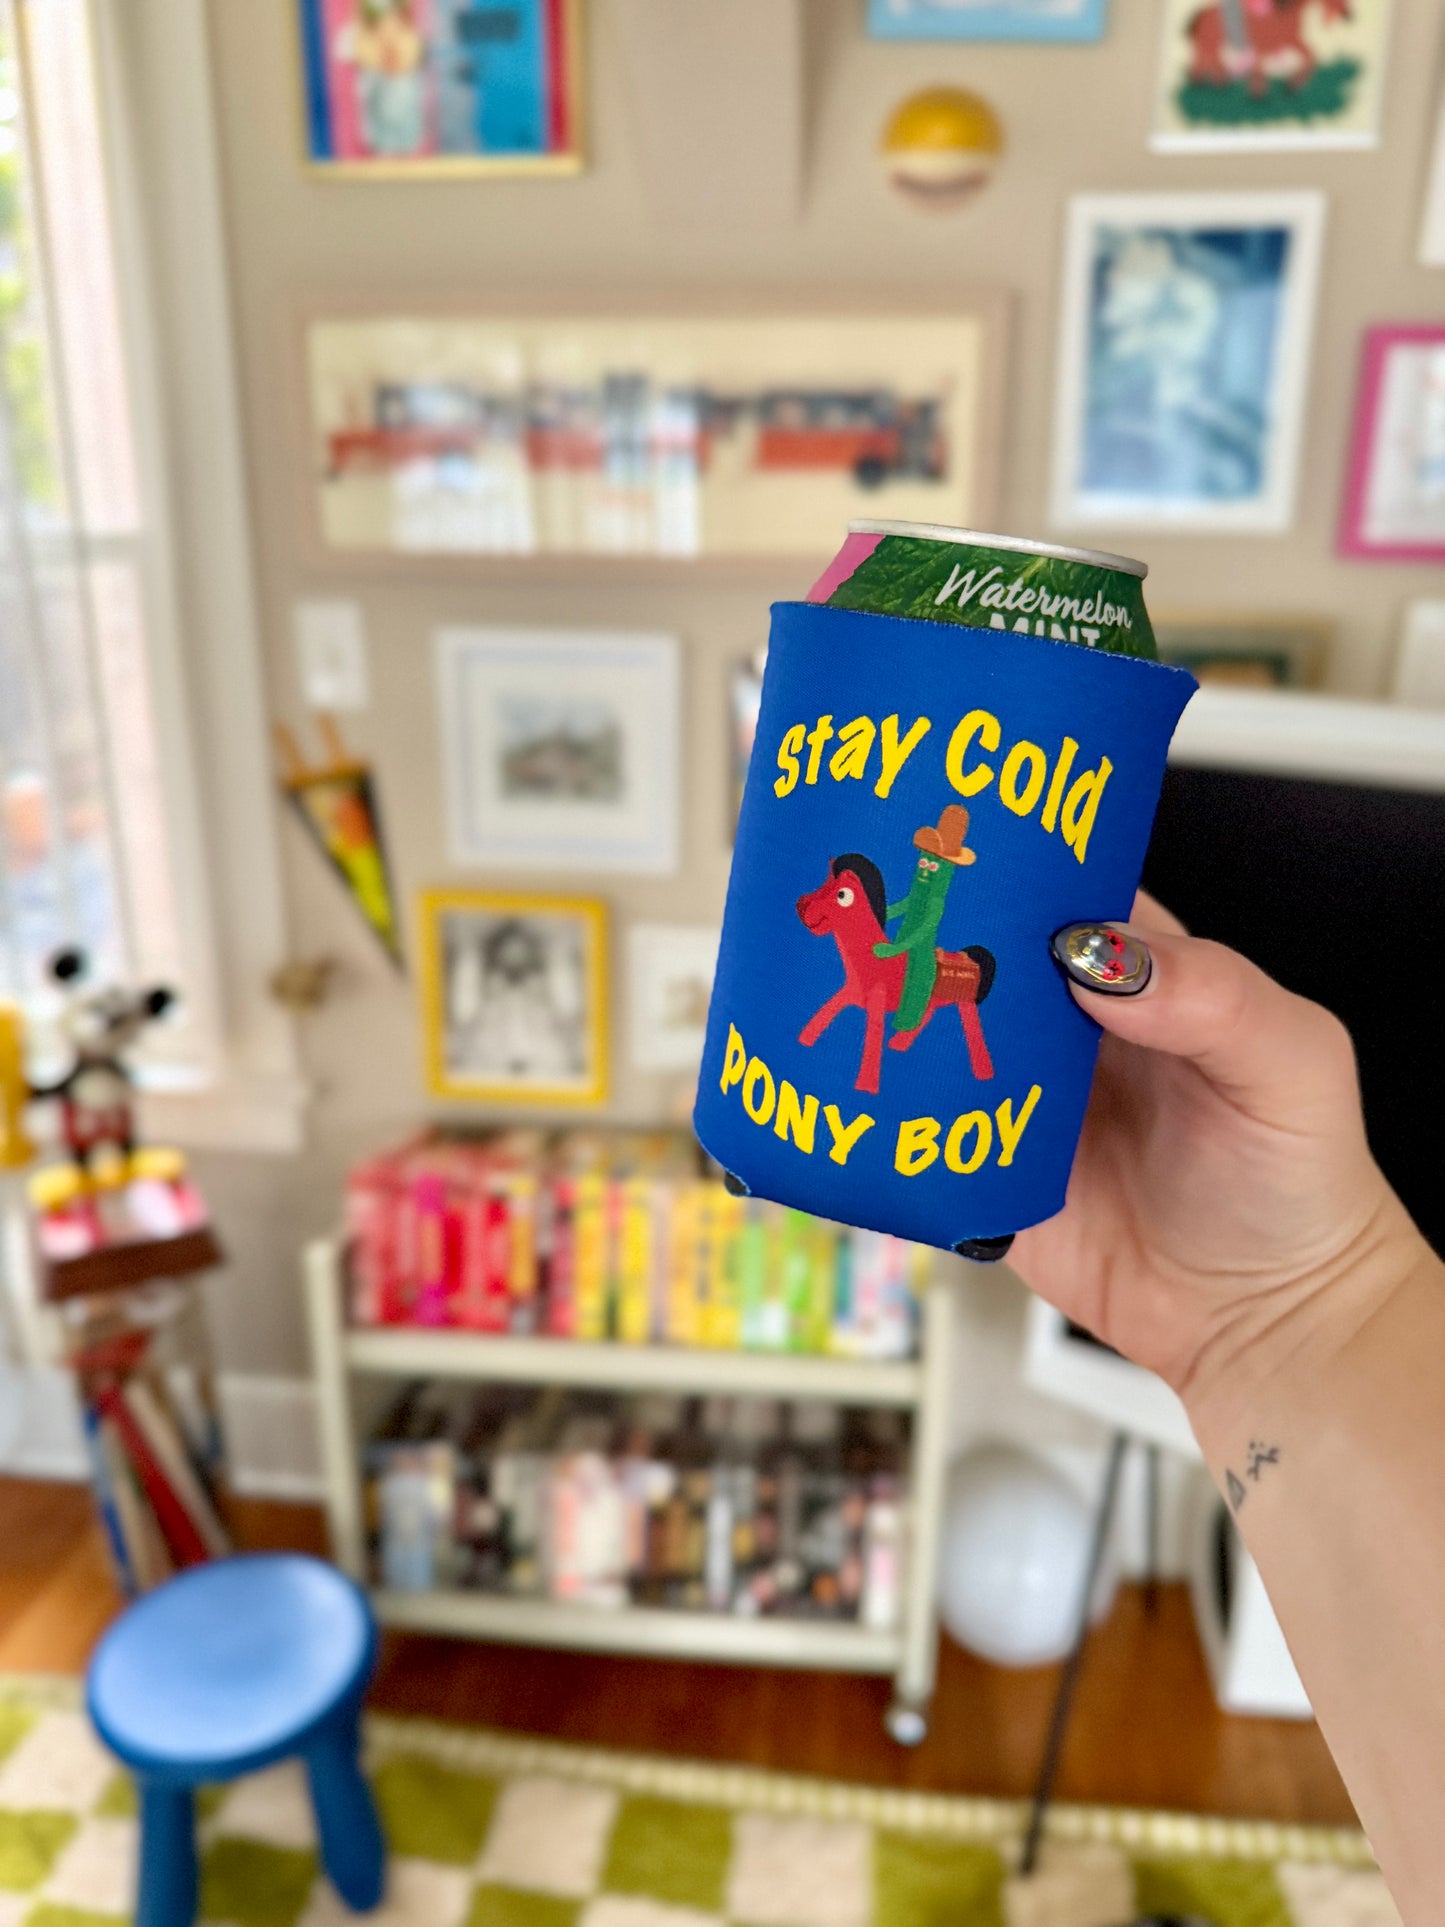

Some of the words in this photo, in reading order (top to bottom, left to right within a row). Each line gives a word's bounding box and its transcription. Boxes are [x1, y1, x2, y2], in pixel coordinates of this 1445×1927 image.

[934, 563, 1132, 629] Watermelon
[945, 709, 1114, 864] Cold
[719, 1022, 875, 1166] PONY
[894, 1084, 1043, 1177] BOY
